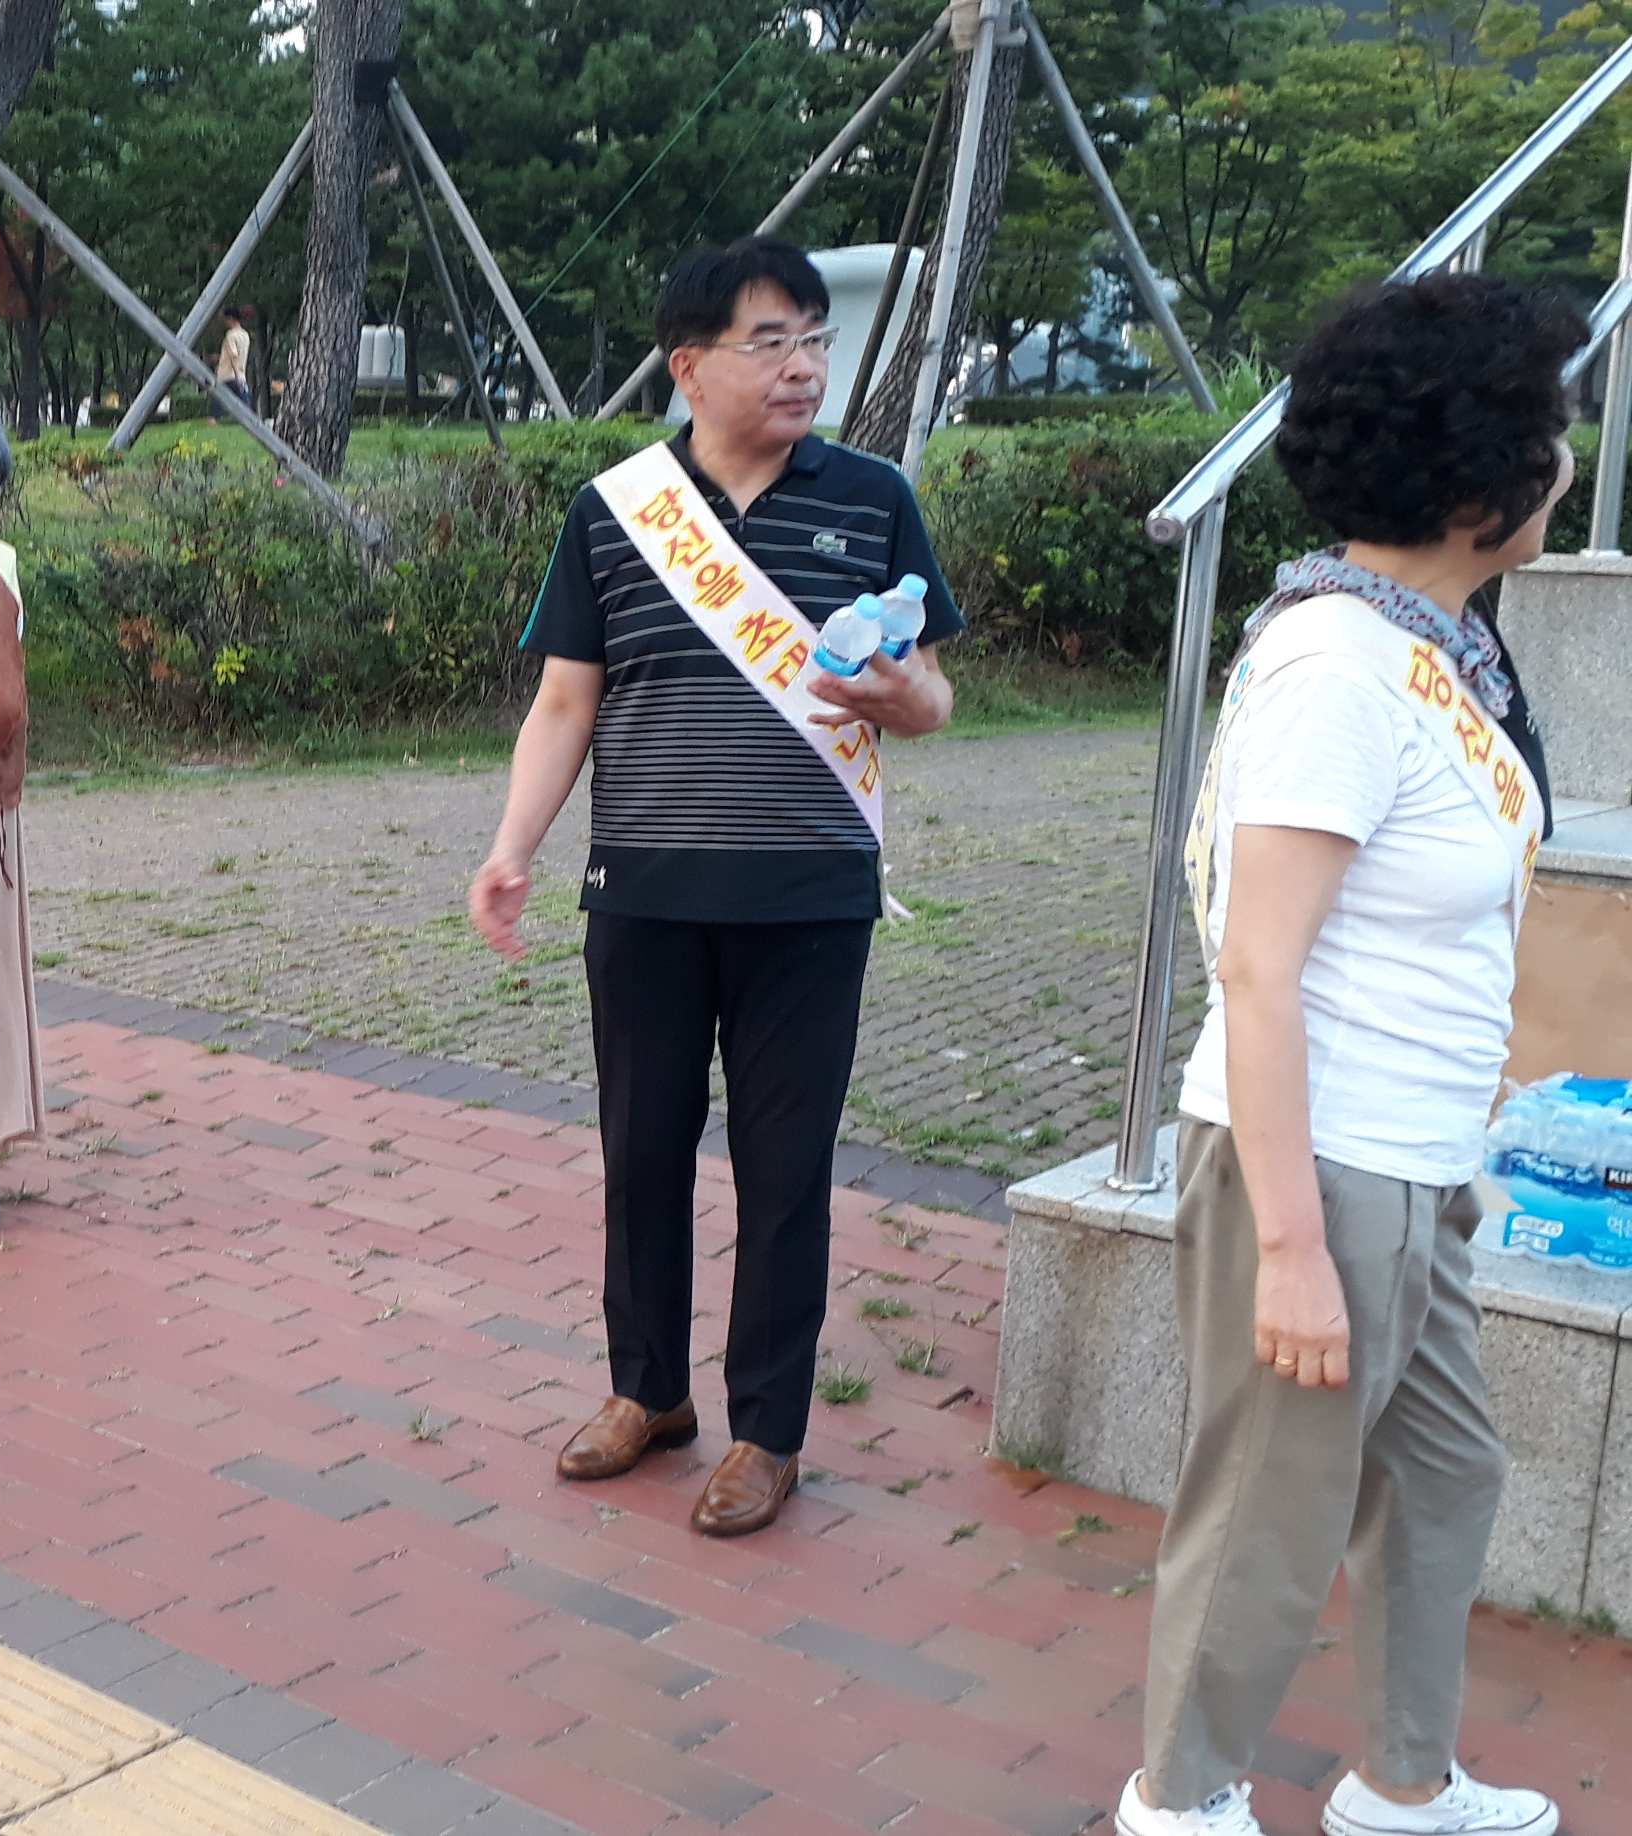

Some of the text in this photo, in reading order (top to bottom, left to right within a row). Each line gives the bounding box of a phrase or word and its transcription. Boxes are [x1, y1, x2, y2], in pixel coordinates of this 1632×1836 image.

[630, 484, 882, 798] 당신을 초대니다
[1406, 641, 1526, 825] 당신을
